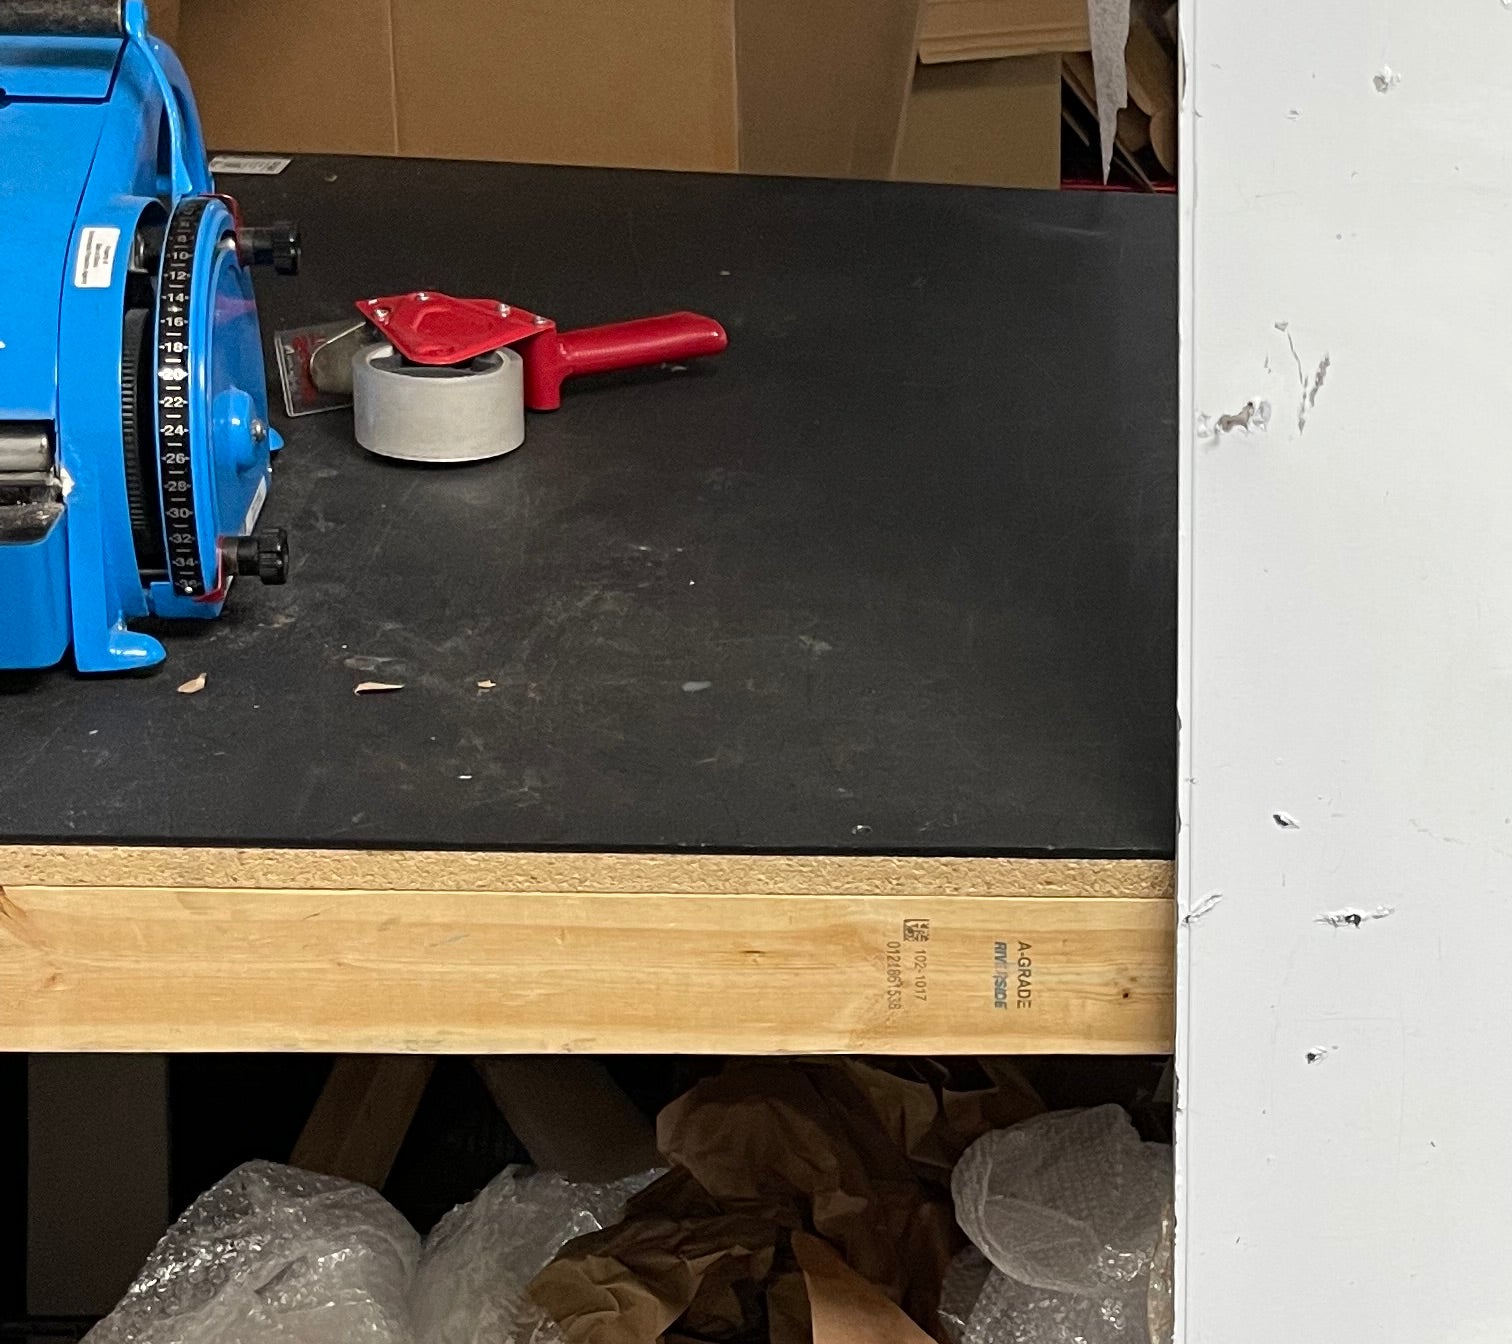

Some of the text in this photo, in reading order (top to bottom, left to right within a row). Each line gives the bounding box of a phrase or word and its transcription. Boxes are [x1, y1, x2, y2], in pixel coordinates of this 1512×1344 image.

[172, 251, 189, 260] 10
[169, 270, 187, 280] 12
[167, 292, 185, 302] 14
[165, 316, 184, 327] 16
[164, 341, 183, 353] 18
[161, 367, 185, 381] 20
[163, 396, 184, 408] 22
[164, 424, 184, 436] 24
[166, 453, 186, 464] 26
[167, 480, 187, 492] 28
[169, 507, 190, 519] 30
[172, 533, 192, 544] 32
[175, 557, 194, 567] 34
[914, 950, 927, 1001] 102-1017
[1017, 940, 1032, 1009] A-GRADE
